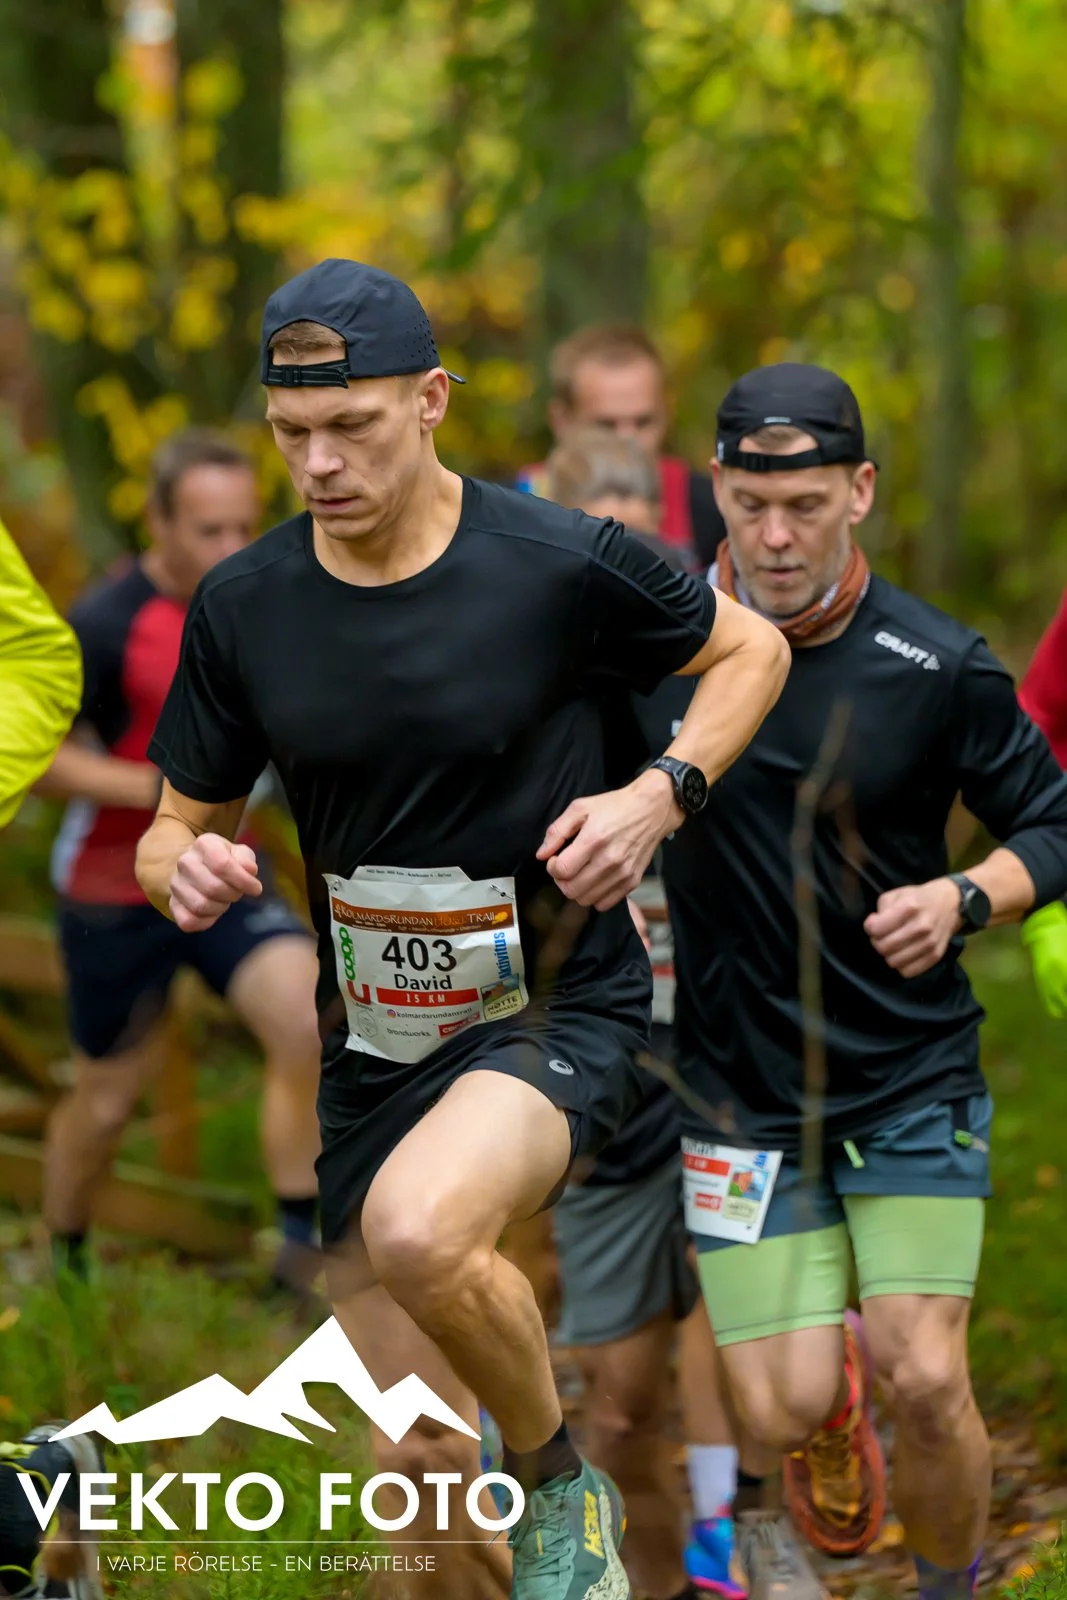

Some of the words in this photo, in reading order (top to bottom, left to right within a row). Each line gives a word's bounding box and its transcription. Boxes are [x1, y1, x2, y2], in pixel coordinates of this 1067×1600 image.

[874, 630, 930, 664] CRAFT
[339, 926, 356, 981] coop
[382, 936, 457, 972] 403
[394, 973, 453, 990] David
[406, 993, 420, 1004] 15
[428, 993, 447, 1004] KM
